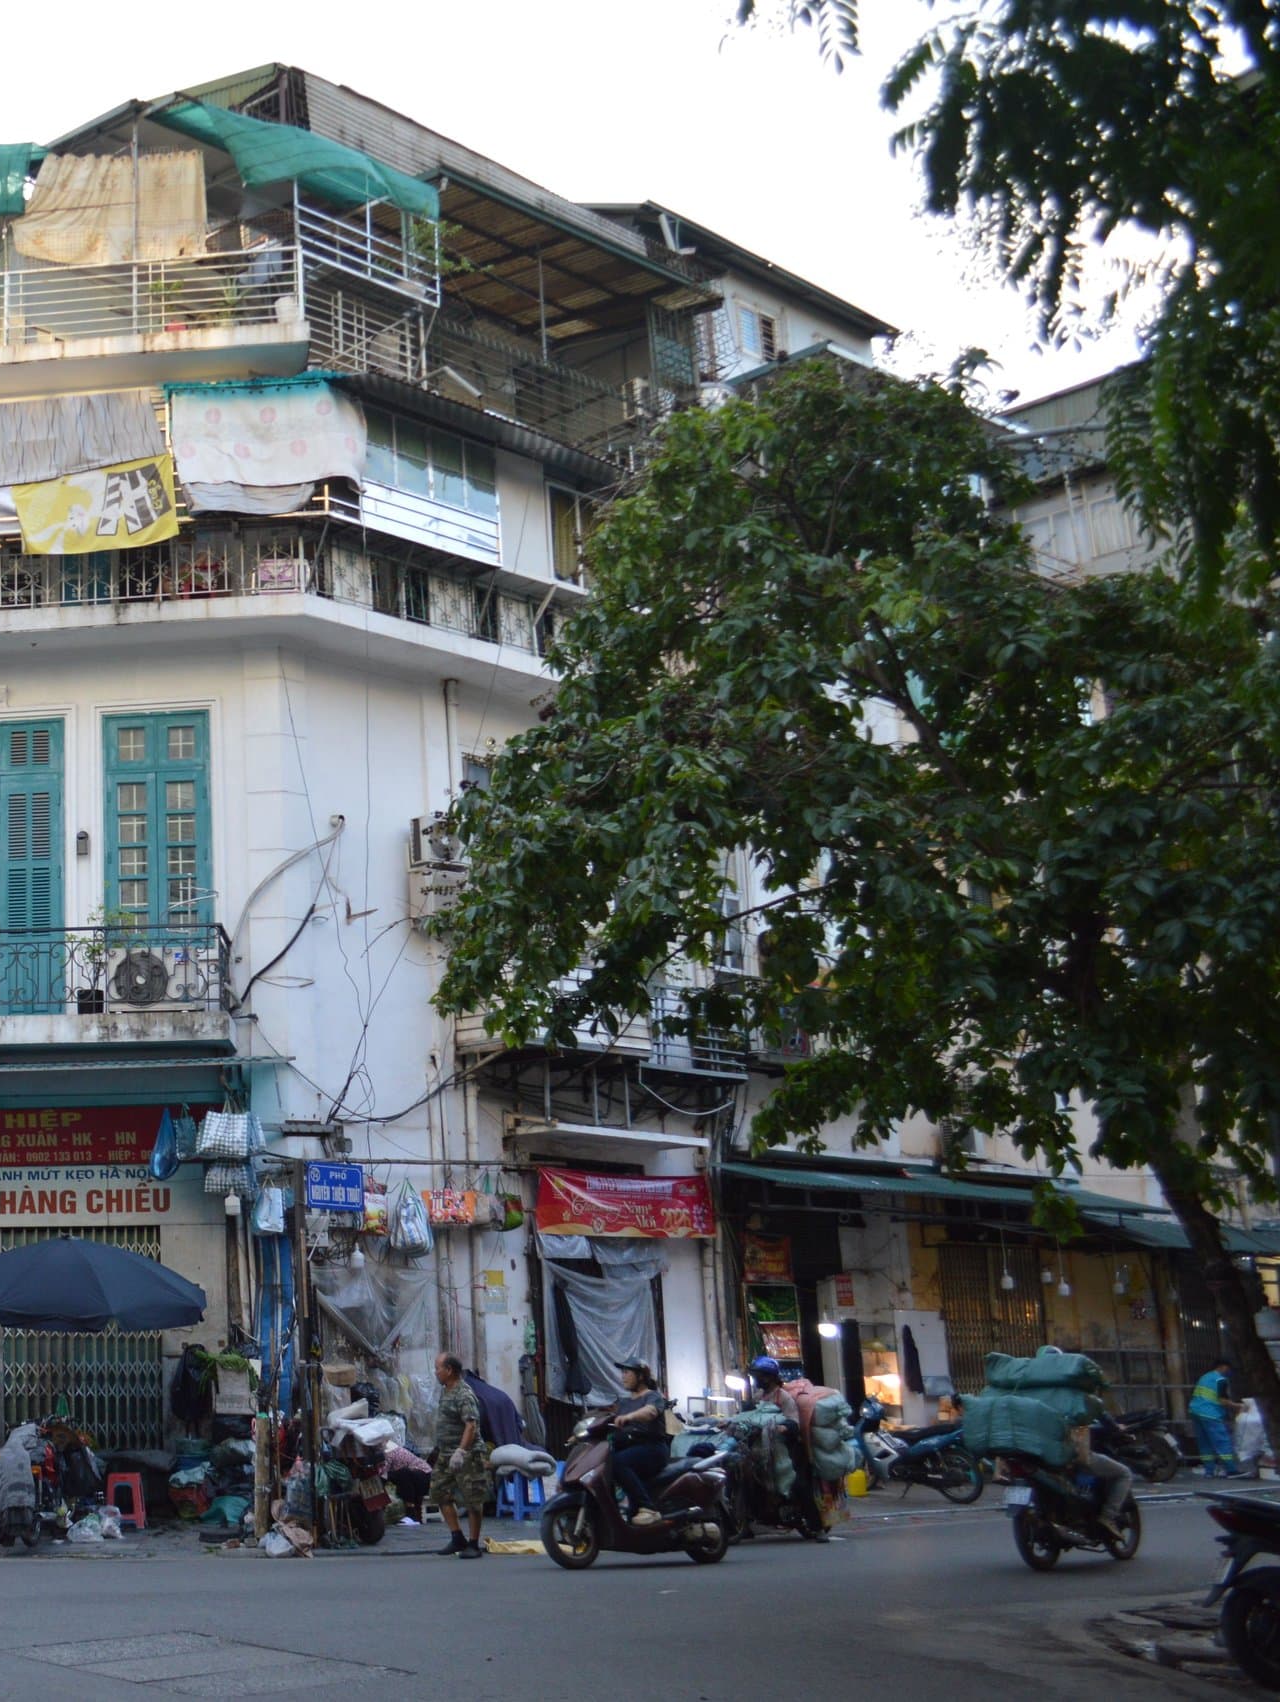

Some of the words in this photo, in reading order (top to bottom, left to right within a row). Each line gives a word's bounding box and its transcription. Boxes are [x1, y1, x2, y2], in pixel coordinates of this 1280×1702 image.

[4, 1109, 82, 1131] HIỆP
[15, 1130, 58, 1148] XUÂN
[72, 1131, 93, 1146] HK
[115, 1131, 137, 1146] HN
[28, 1167, 60, 1180] MỨT
[65, 1169, 95, 1183] KẸO
[99, 1166, 121, 1180] HÀ
[125, 1165, 151, 1182] NỘI
[329, 1169, 347, 1181] PHỐ
[0, 1185, 77, 1215] HÀNG
[86, 1179, 171, 1214] CHIẾU
